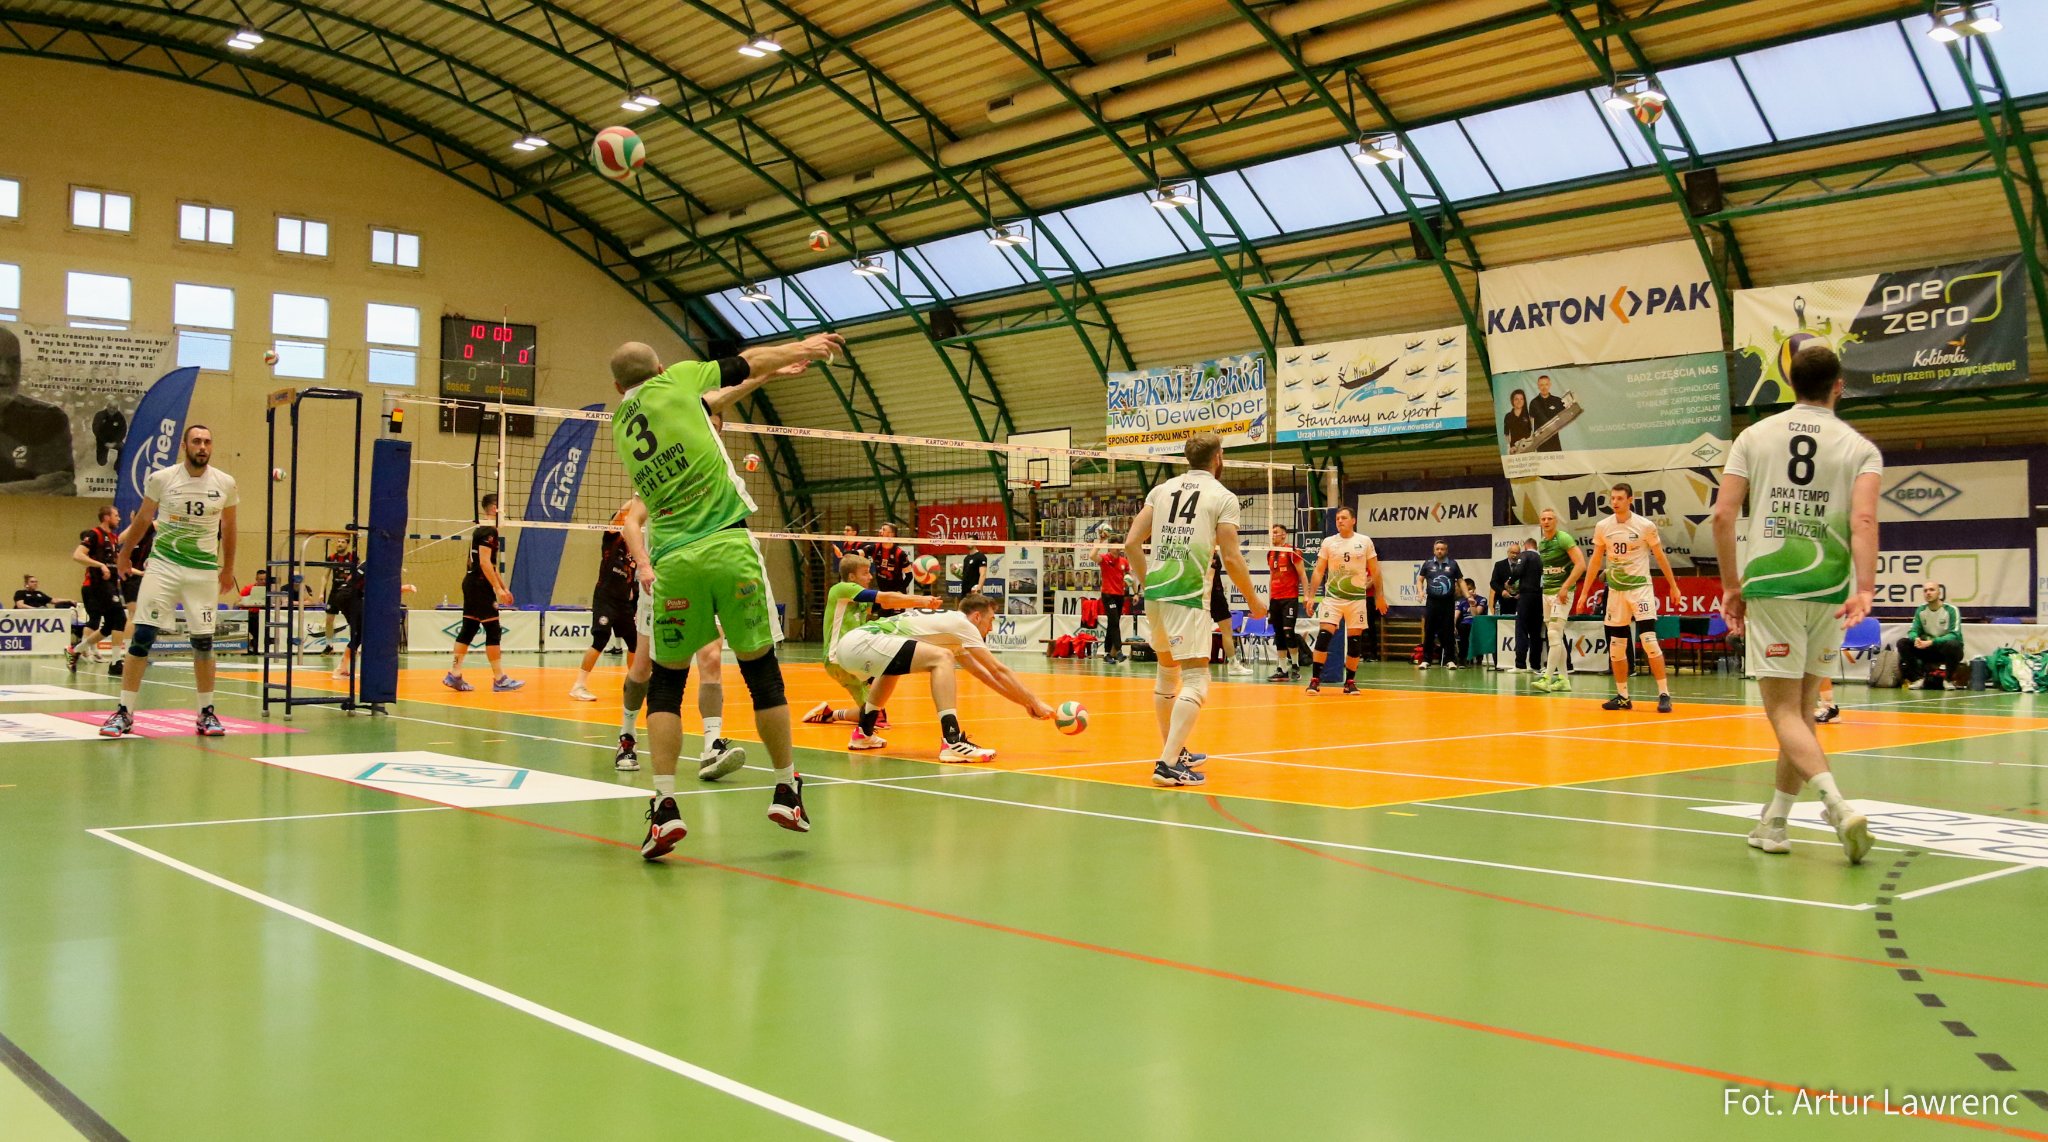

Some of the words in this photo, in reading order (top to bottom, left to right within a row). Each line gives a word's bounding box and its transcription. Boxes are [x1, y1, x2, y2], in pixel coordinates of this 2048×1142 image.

[1882, 279, 1944, 312] pre
[1488, 294, 1606, 335] KARTON
[1646, 280, 1712, 314] PAK
[1882, 306, 1968, 334] zero
[464, 344, 474, 358] 0
[519, 350, 528, 364] 0
[1698, 365, 1718, 374] NAS
[1872, 366, 1902, 384] lećmy
[1904, 368, 1935, 382] razem
[1938, 368, 1951, 381] po
[1952, 360, 2016, 377] zwycięstwo!
[1132, 374, 1182, 407] PKM
[1190, 358, 1264, 402] Zachód
[1109, 410, 1150, 431] Twój
[1156, 398, 1264, 426] Deweloper
[1298, 410, 1370, 428] Stawiamy
[1378, 410, 1398, 420] na
[1402, 402, 1442, 423] sport
[626, 413, 658, 462] 3
[1108, 436, 1138, 445] SPONSOR
[1172, 430, 1190, 440] MKST
[634, 465, 652, 486] ARKA
[650, 442, 685, 470] TEMPO
[1788, 434, 1818, 486] 8
[550, 446, 582, 512] Enea
[641, 456, 690, 497] CHEŁM
[1770, 486, 1794, 499] ARKA
[1798, 489, 1830, 502] TEMPO
[1896, 487, 1945, 500] GEDIA
[185, 501, 204, 516] 13
[1168, 490, 1200, 524] 14
[1369, 506, 1429, 522] KARTON
[1448, 504, 1478, 519] PAK
[1772, 501, 1825, 517] CHEŁM
[953, 516, 998, 528] POLSKA
[1306, 537, 1320, 546] pre
[1614, 542, 1627, 554] 30
[1344, 552, 1351, 562] 5
[1288, 608, 1294, 616] 6
[1639, 602, 1648, 612] 30
[1654, 596, 1722, 612] LSKA
[202, 612, 212, 622] 13
[1360, 614, 1364, 622] 5
[550, 626, 590, 637] KART
[5, 636, 24, 650] SÓL
